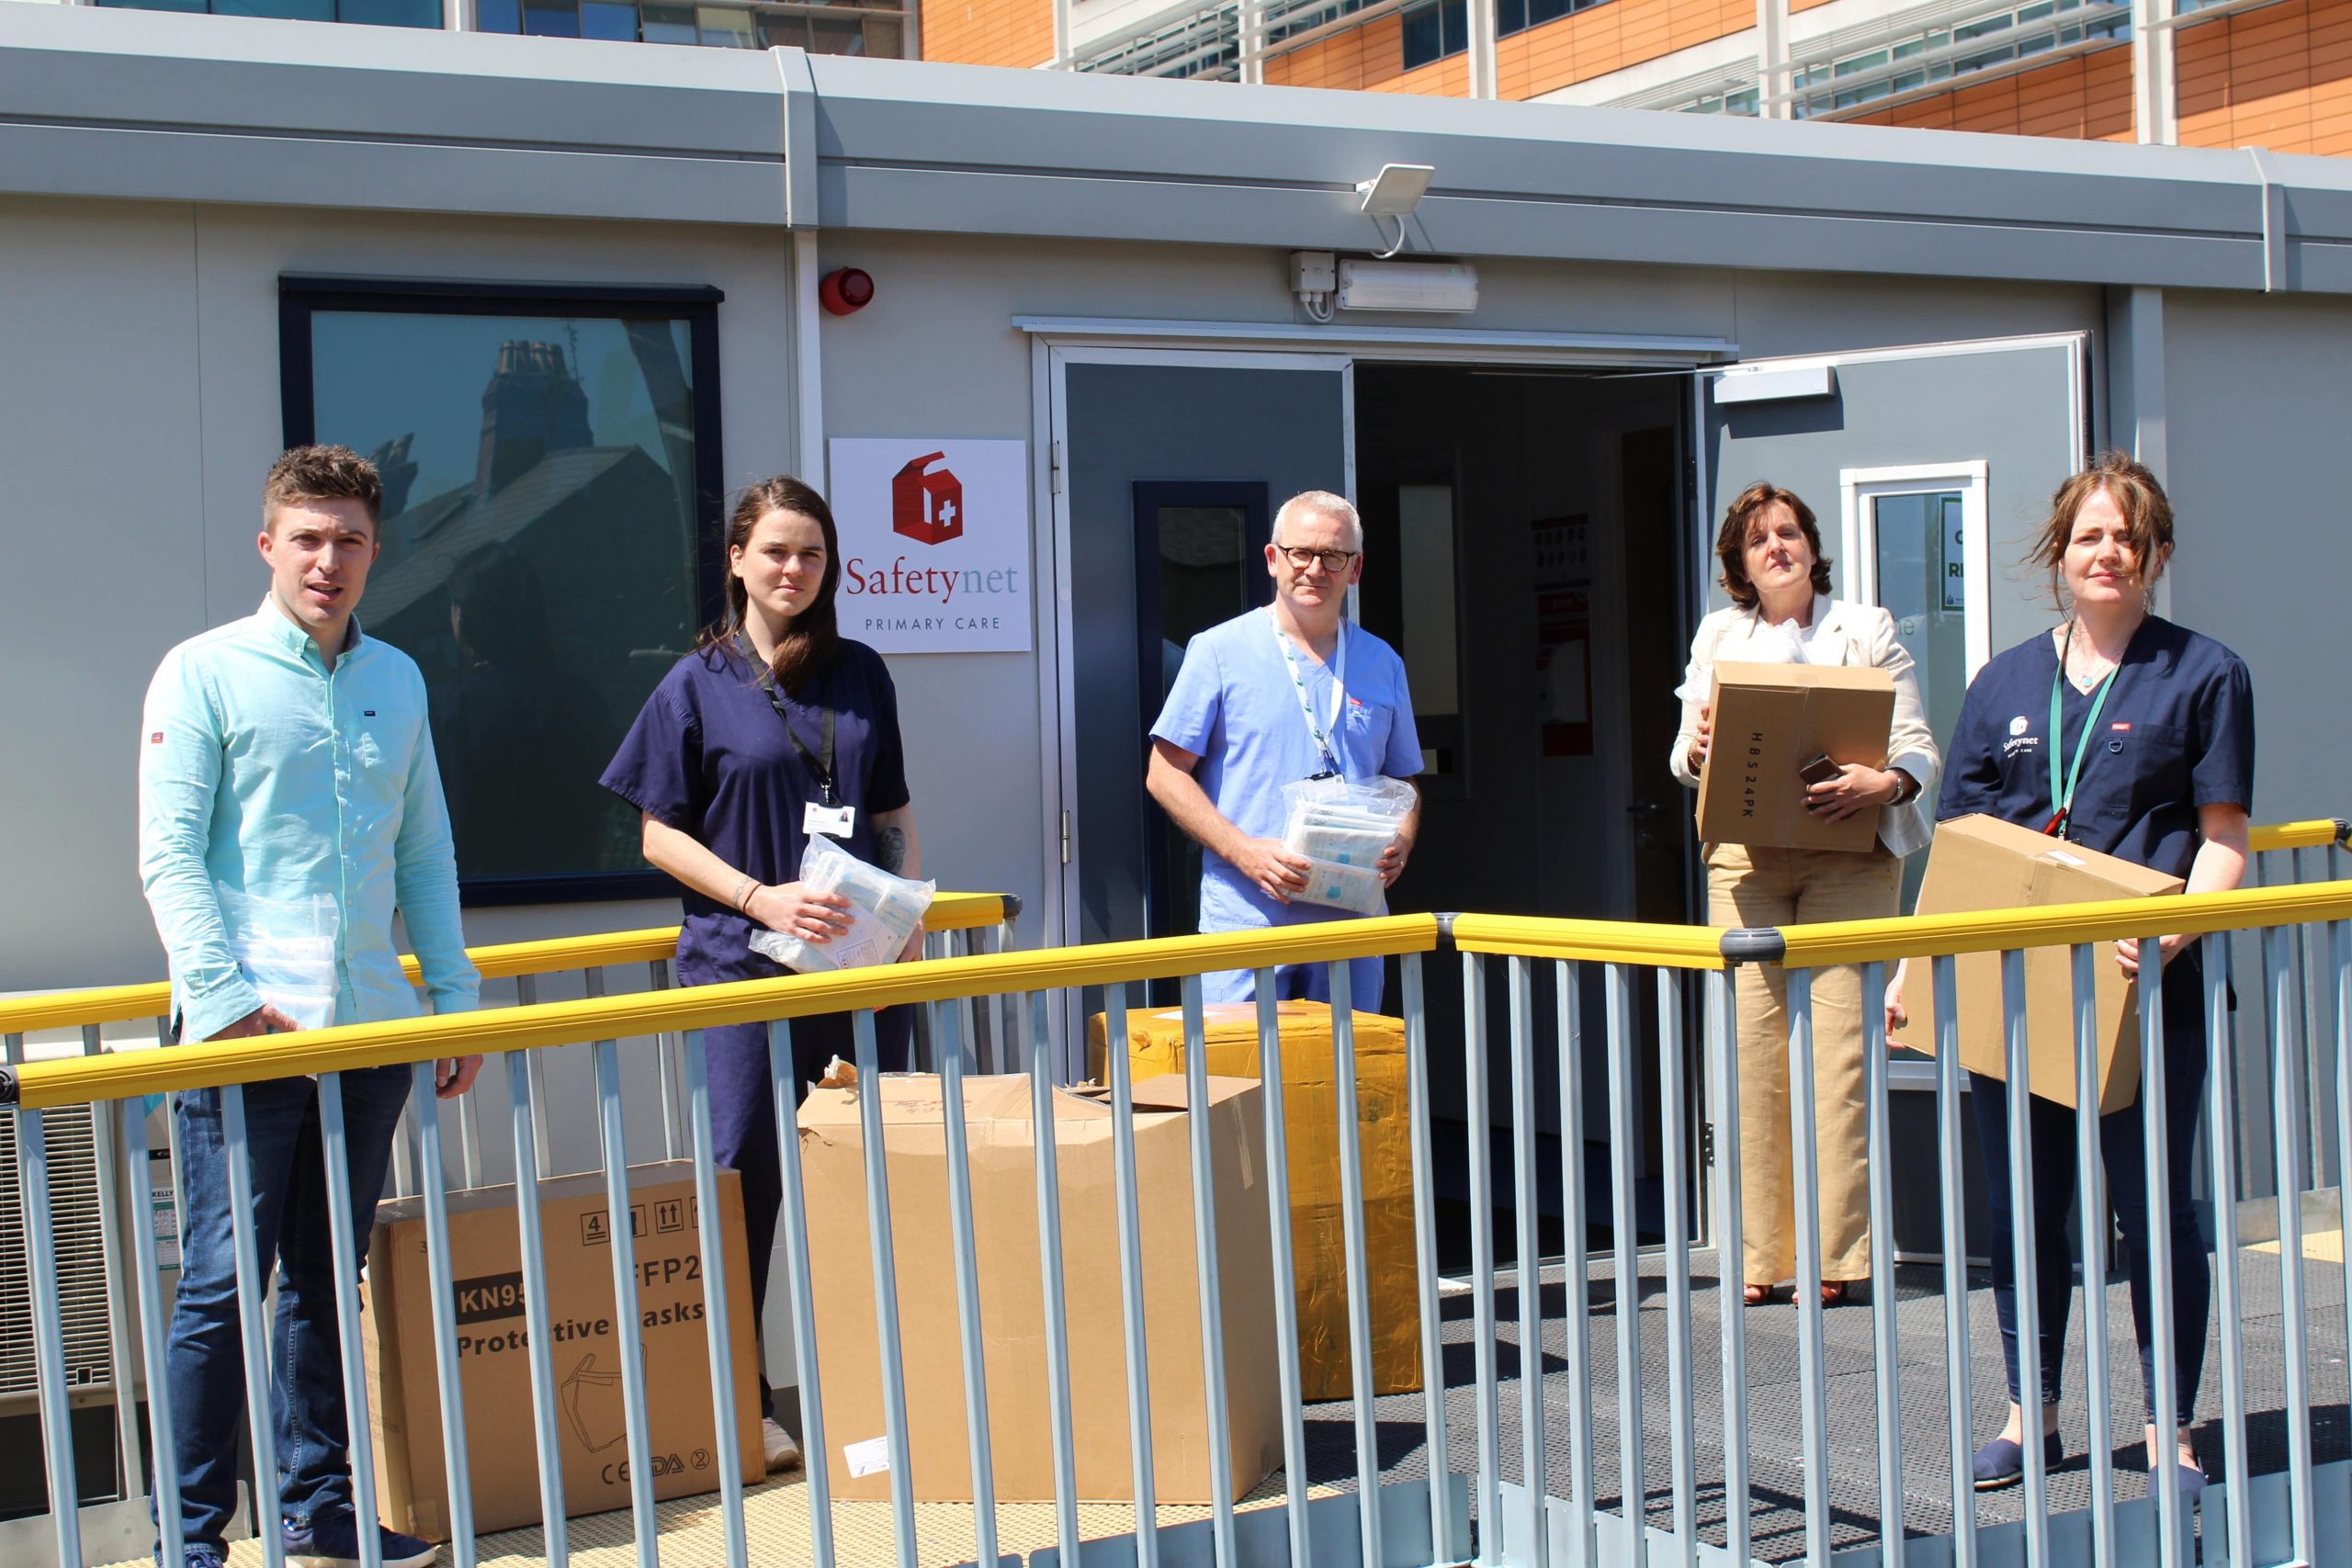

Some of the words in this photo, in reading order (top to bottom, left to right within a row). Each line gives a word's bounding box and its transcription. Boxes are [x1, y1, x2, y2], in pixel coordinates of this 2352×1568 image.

[846, 556, 1019, 604] Safetynet
[865, 618, 944, 631] PRIMARY
[955, 617, 1001, 630] CARE
[1742, 732, 1764, 818] HBS24PK
[588, 1215, 601, 1232] 4
[634, 1255, 701, 1287] FP2
[458, 1317, 609, 1358] Protetive
[642, 1302, 705, 1328] asks
